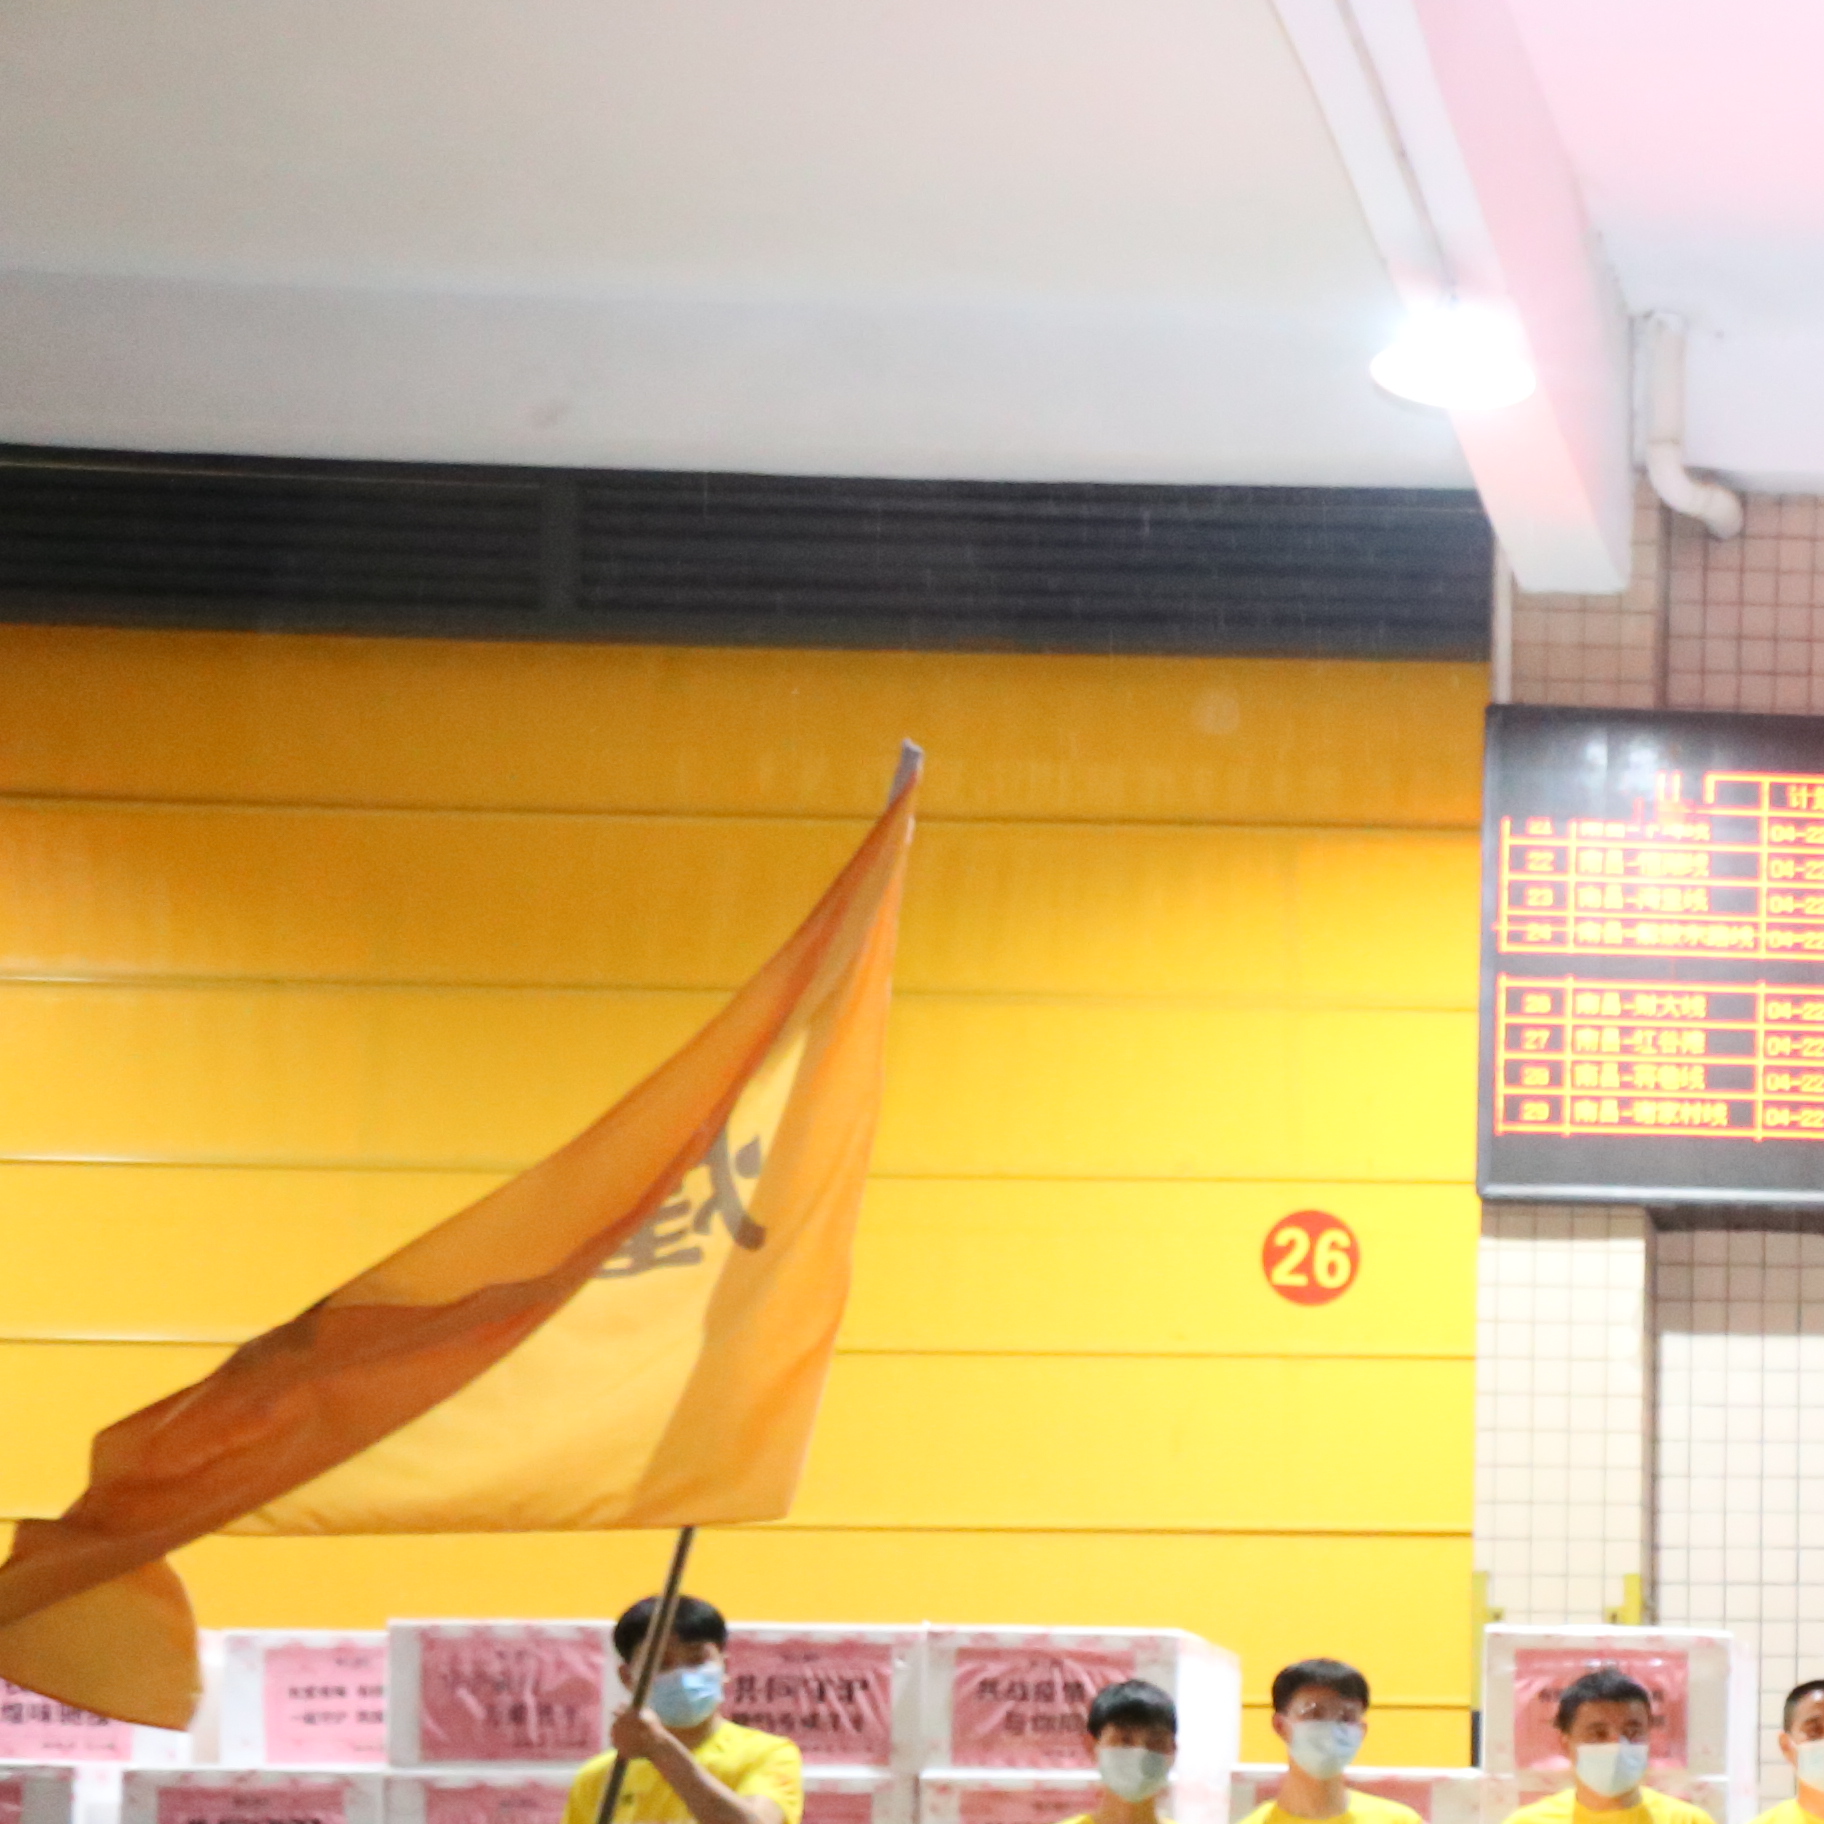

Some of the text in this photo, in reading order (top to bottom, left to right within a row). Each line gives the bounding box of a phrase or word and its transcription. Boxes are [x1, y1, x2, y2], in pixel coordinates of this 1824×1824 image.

[1525, 851, 1555, 872] 22
[1525, 887, 1554, 907] 23
[1522, 1029, 1552, 1051] 27
[1270, 1226, 1352, 1289] 26
